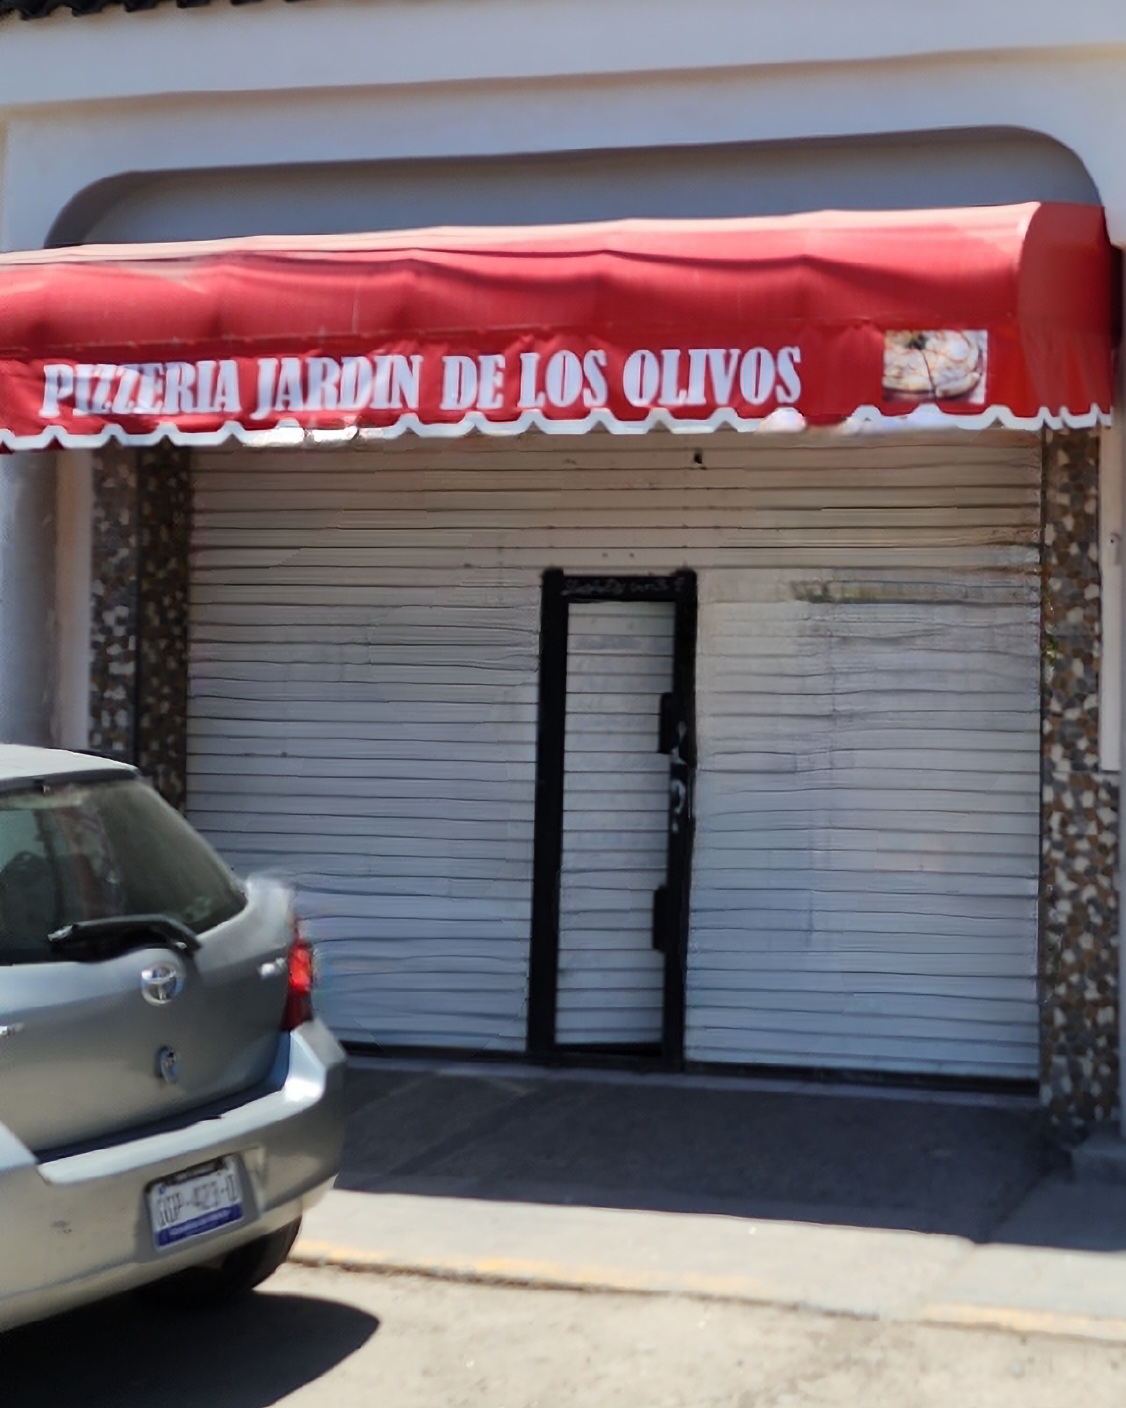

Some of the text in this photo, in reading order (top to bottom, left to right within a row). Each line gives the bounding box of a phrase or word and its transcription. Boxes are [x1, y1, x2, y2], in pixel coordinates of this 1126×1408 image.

[38, 346, 802, 420] PIZZERIA JARDIN DE LOS OLIVOS
